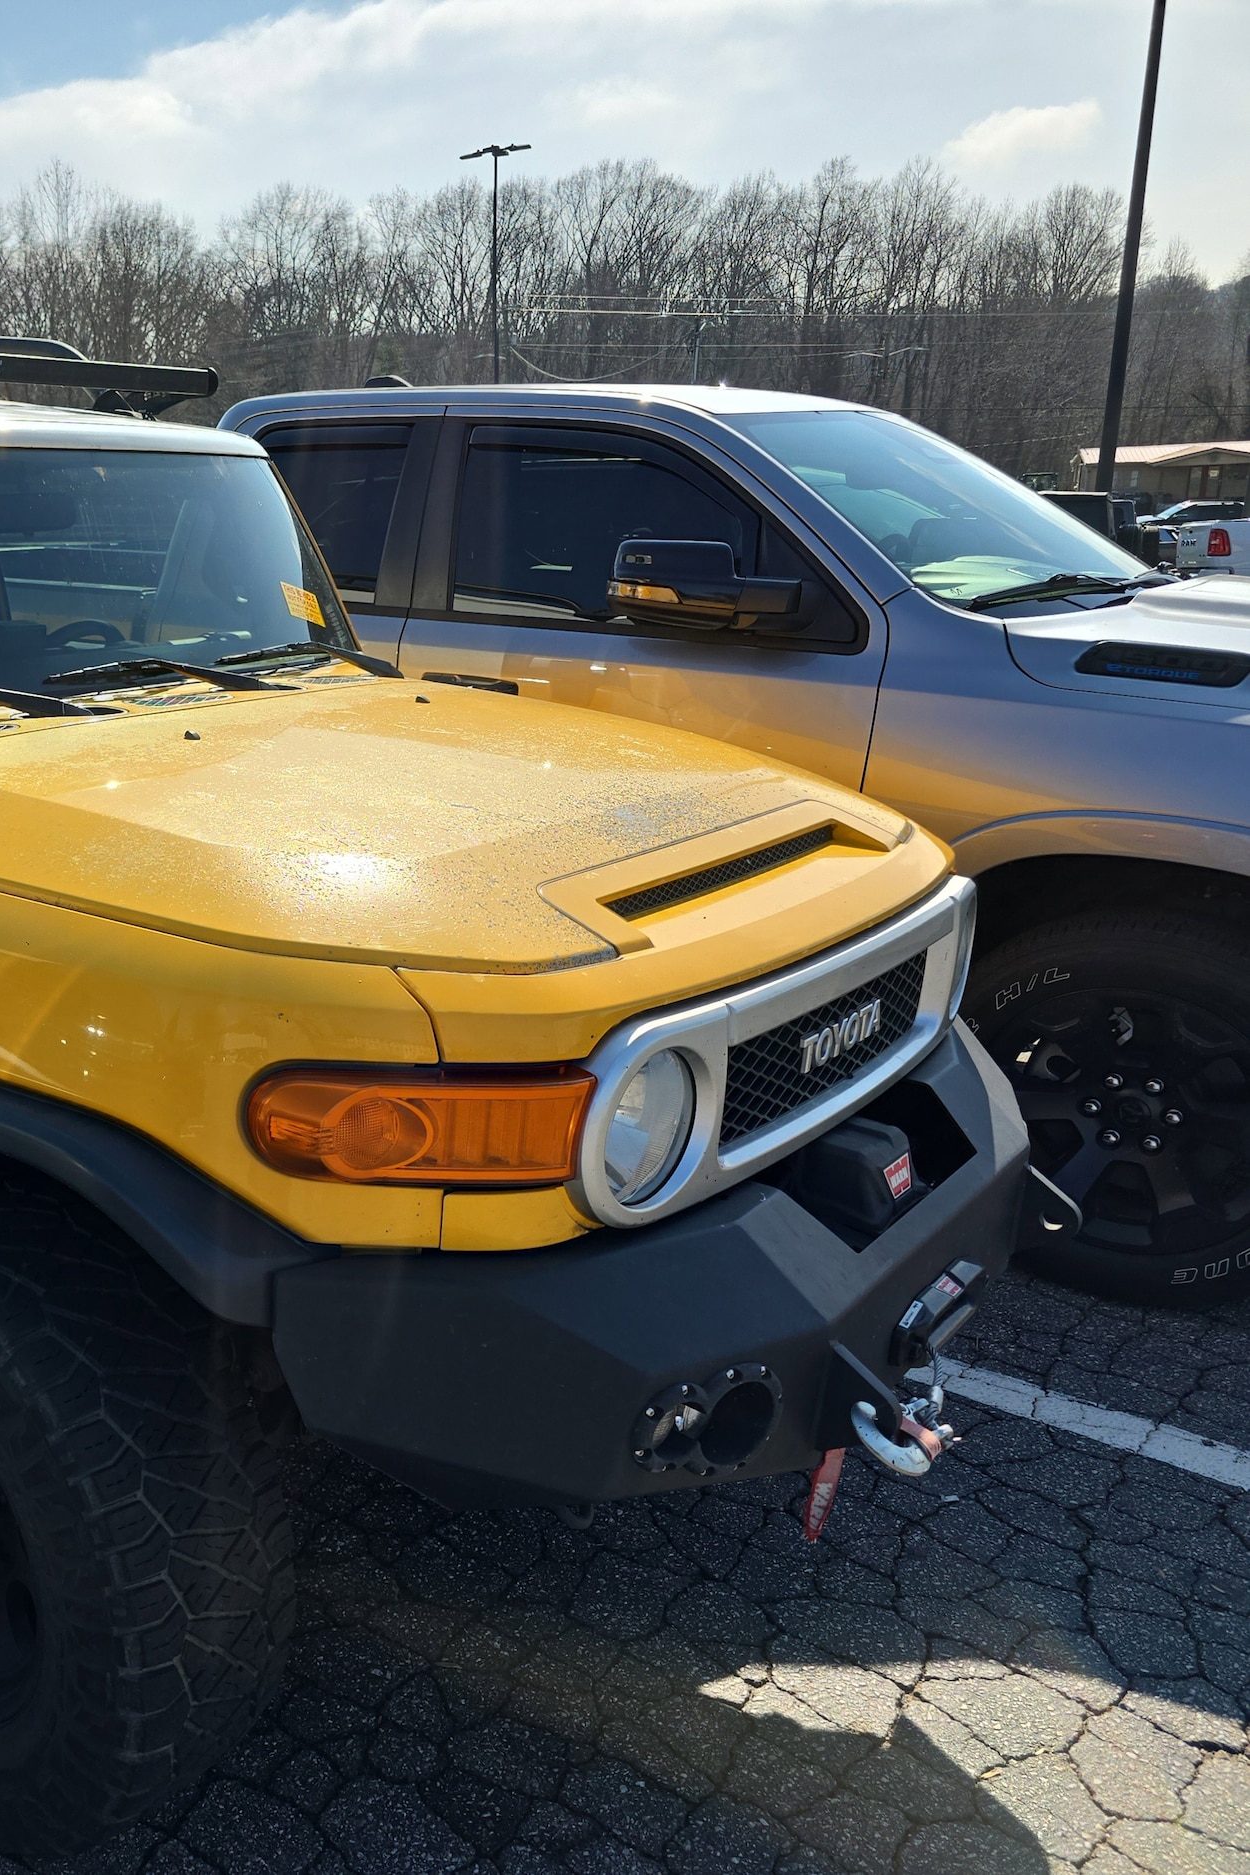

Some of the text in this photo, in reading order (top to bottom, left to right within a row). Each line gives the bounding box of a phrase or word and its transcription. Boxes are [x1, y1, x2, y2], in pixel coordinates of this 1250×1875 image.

[995, 967, 1070, 1010] H/L
[801, 998, 881, 1074] TOYOTA
[890, 1166, 909, 1189] WARN
